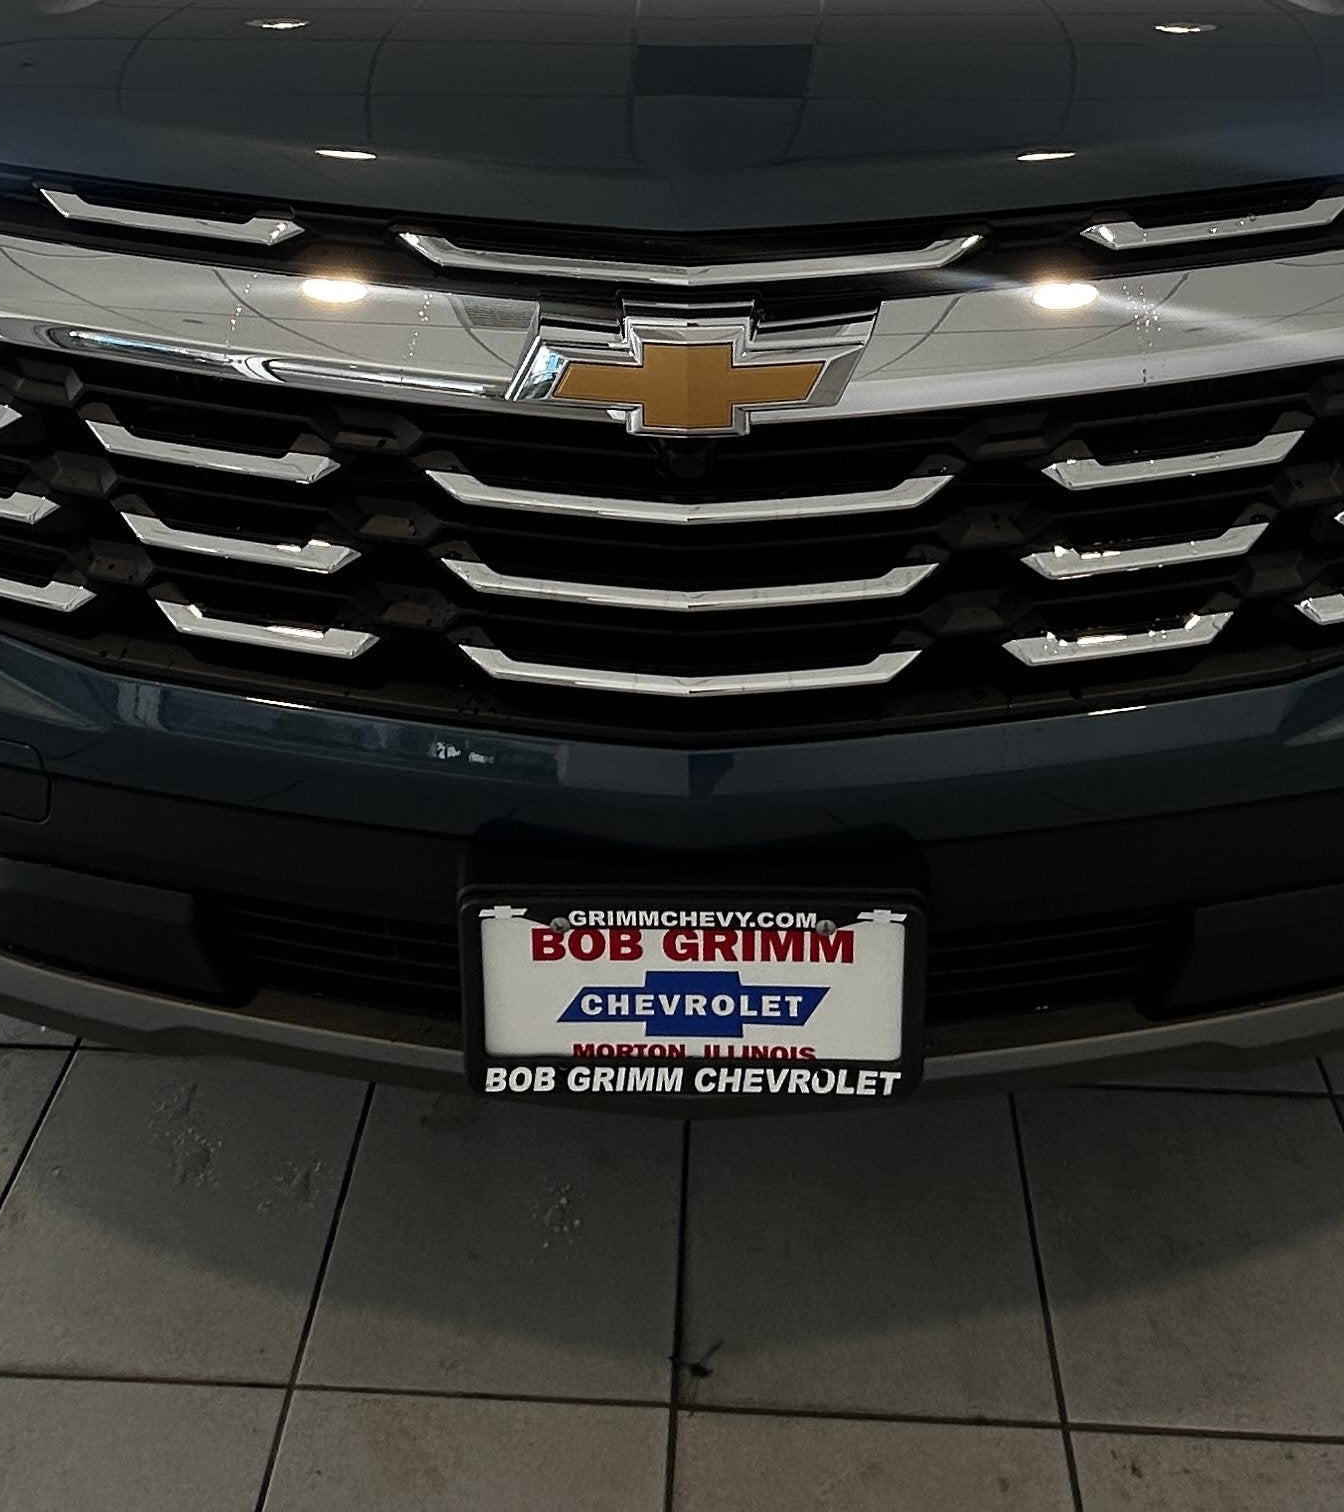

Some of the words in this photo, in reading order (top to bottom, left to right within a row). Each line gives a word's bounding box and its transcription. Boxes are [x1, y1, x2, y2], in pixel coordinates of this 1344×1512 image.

[567, 910, 817, 929] GRIMMCHEVY.COM
[531, 928, 644, 962] BOB
[662, 928, 855, 964] GRIMM
[580, 993, 804, 1018] CHEVROLET
[484, 1066, 556, 1093] BOB
[566, 1066, 685, 1093] GRIMM
[693, 1067, 903, 1096] CHEVROLET
